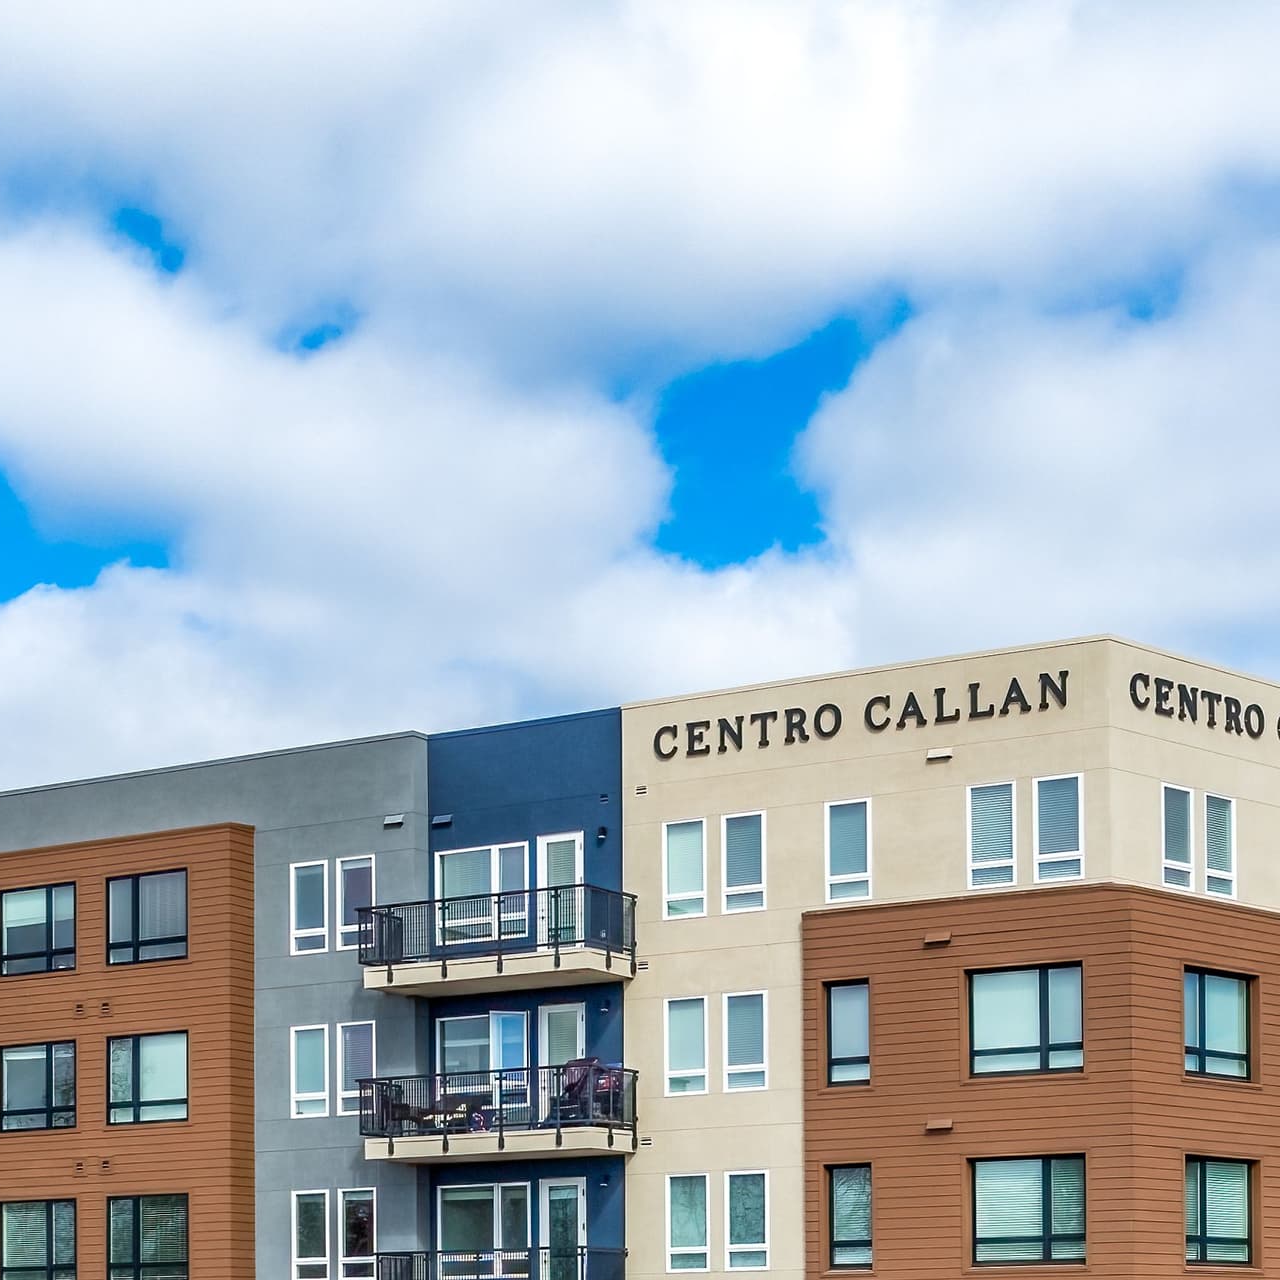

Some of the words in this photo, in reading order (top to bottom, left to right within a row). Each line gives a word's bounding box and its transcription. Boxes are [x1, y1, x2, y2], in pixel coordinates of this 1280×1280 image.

[653, 702, 842, 760] CENTRO
[863, 669, 1070, 731] CALLAN
[1129, 672, 1265, 740] CENTRO
